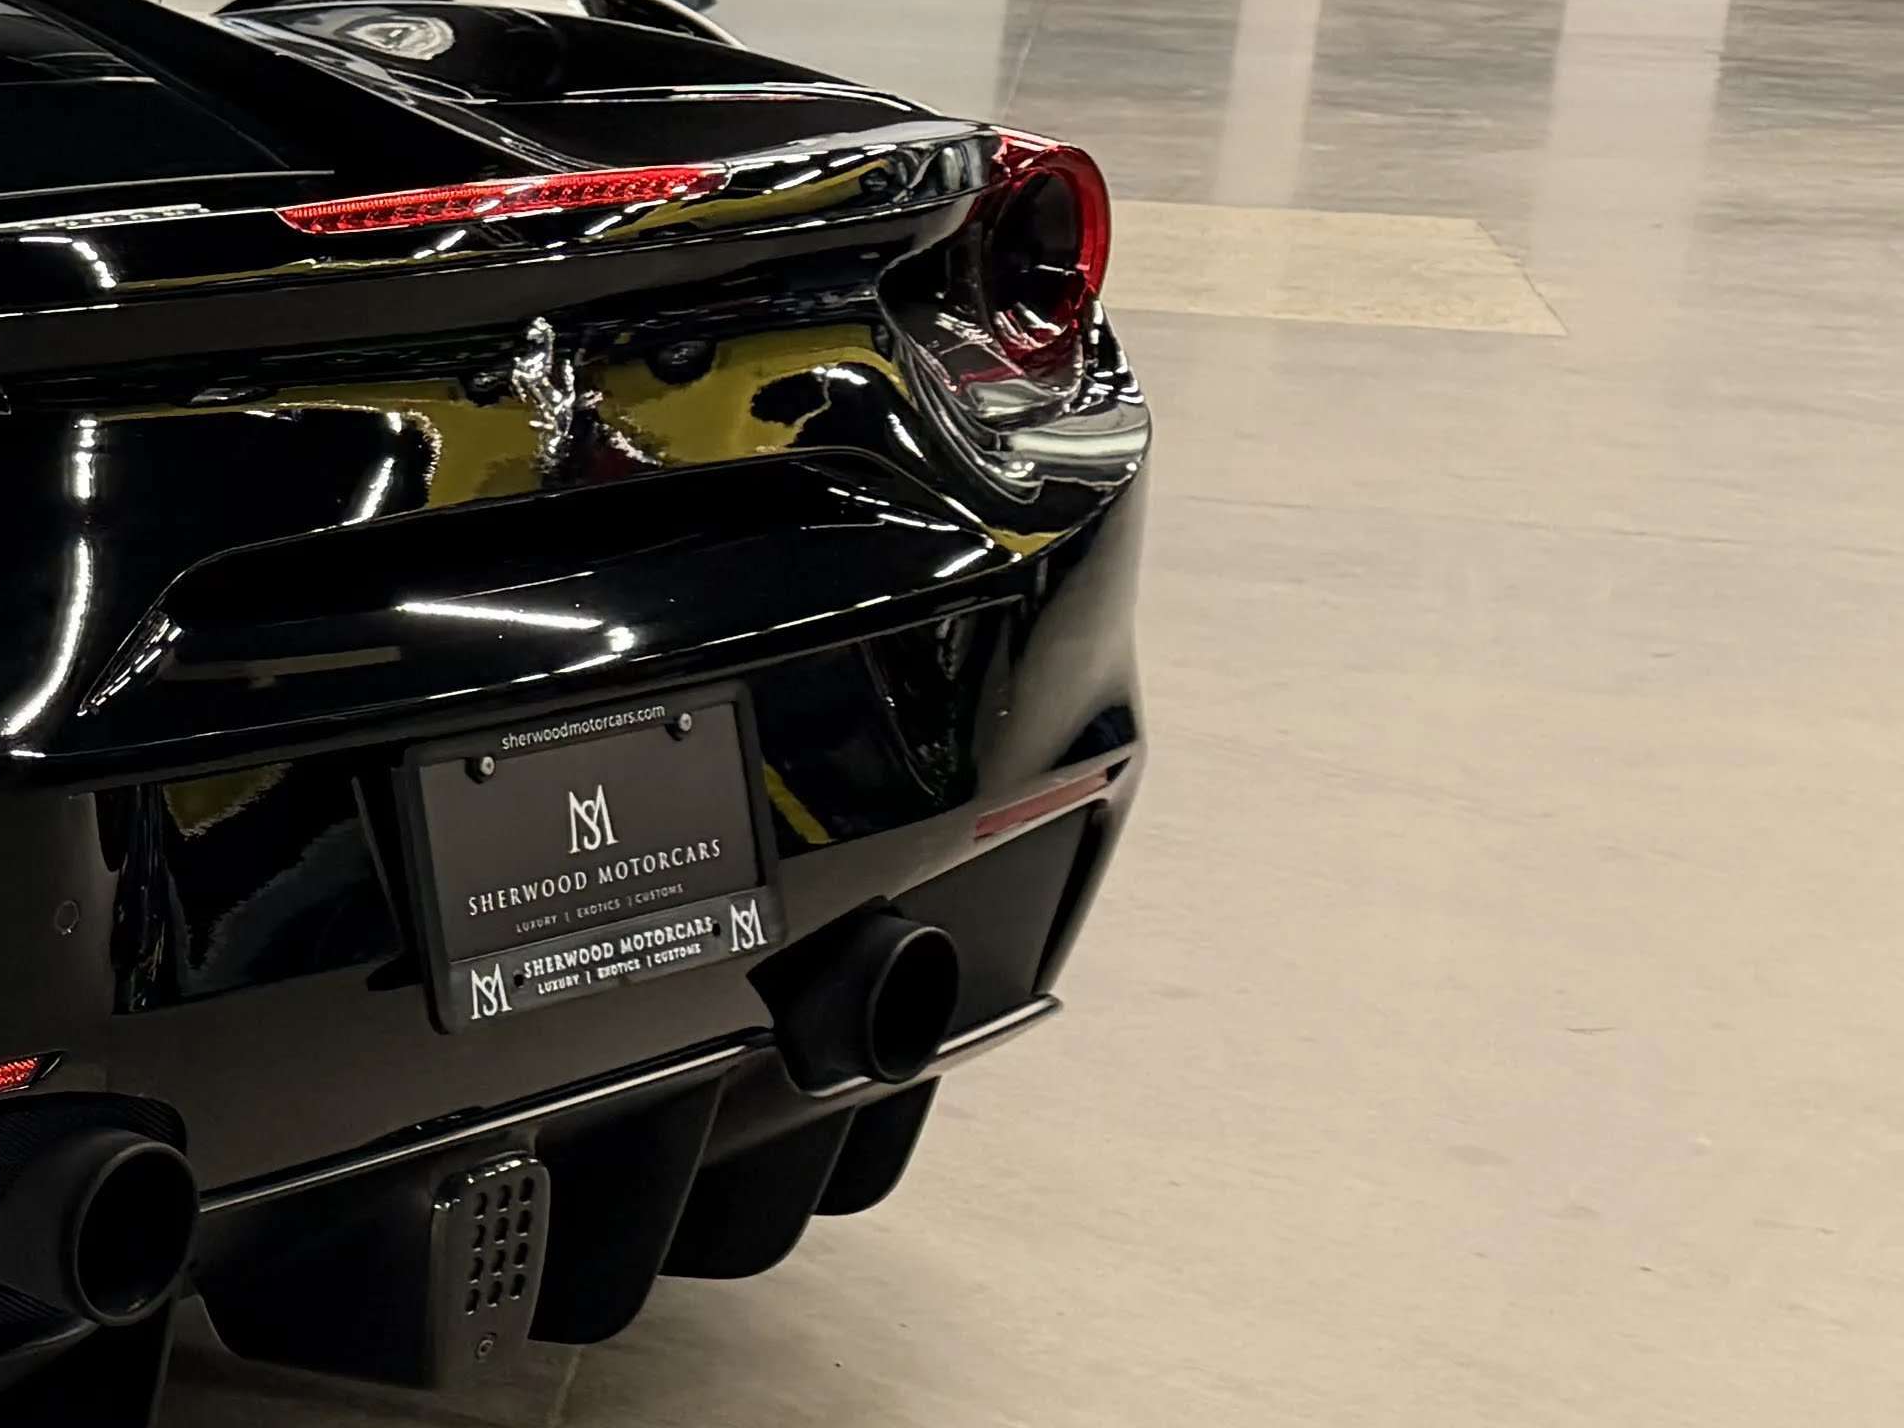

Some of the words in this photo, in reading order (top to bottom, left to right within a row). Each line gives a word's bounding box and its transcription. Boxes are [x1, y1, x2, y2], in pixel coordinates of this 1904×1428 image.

[502, 705, 665, 750] sherwoodmotorcars.com
[469, 871, 588, 916] SHERWOOD
[598, 839, 722, 884] MOTORCARS
[515, 915, 558, 933] LUXURY
[576, 898, 621, 919] EXOTICS
[635, 883, 684, 905] CUSTOMS
[523, 941, 614, 979] SHERWOOD
[619, 915, 714, 955] MOTORCARS
[537, 973, 580, 996] LUXURY
[596, 959, 642, 980] EXOTICS
[654, 943, 702, 966] CUSTOMS
